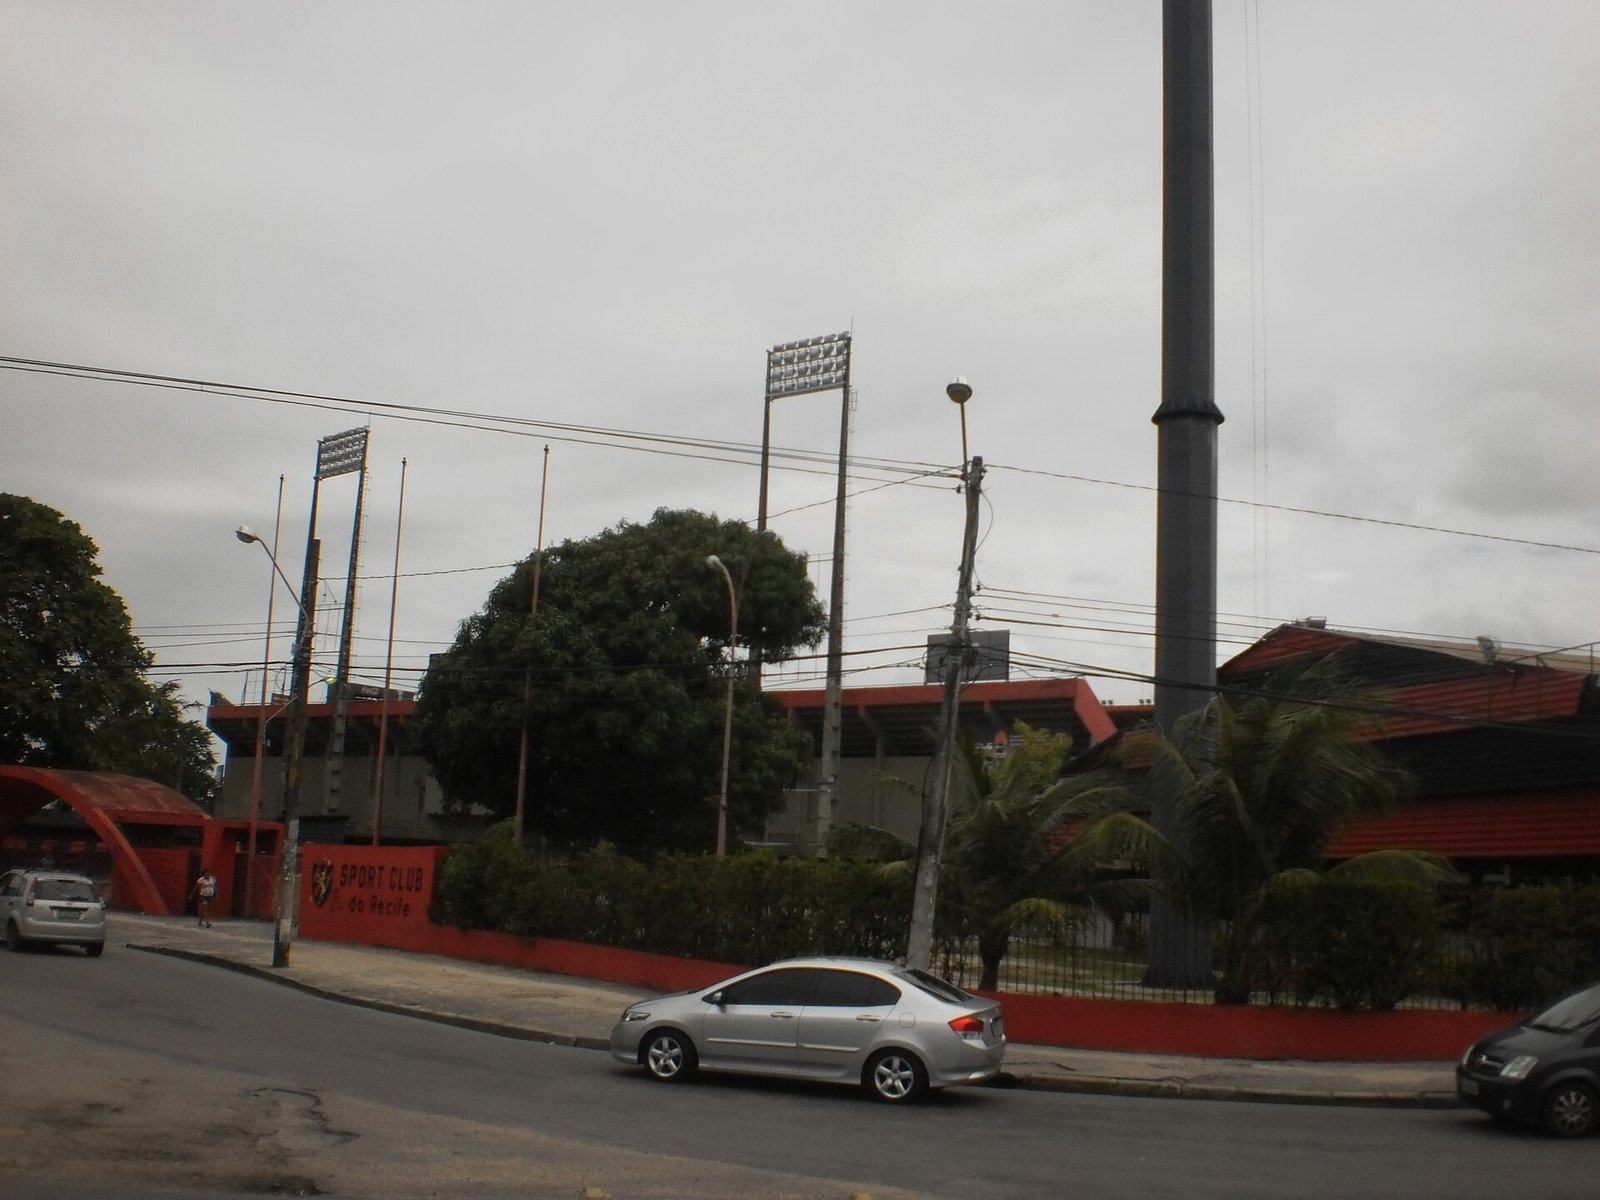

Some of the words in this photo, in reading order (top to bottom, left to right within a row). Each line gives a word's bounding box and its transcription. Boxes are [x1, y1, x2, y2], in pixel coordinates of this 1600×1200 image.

[341, 864, 384, 889] SPORT
[389, 866, 423, 892] CLUB
[348, 894, 364, 913] do
[370, 895, 410, 917] Recife
